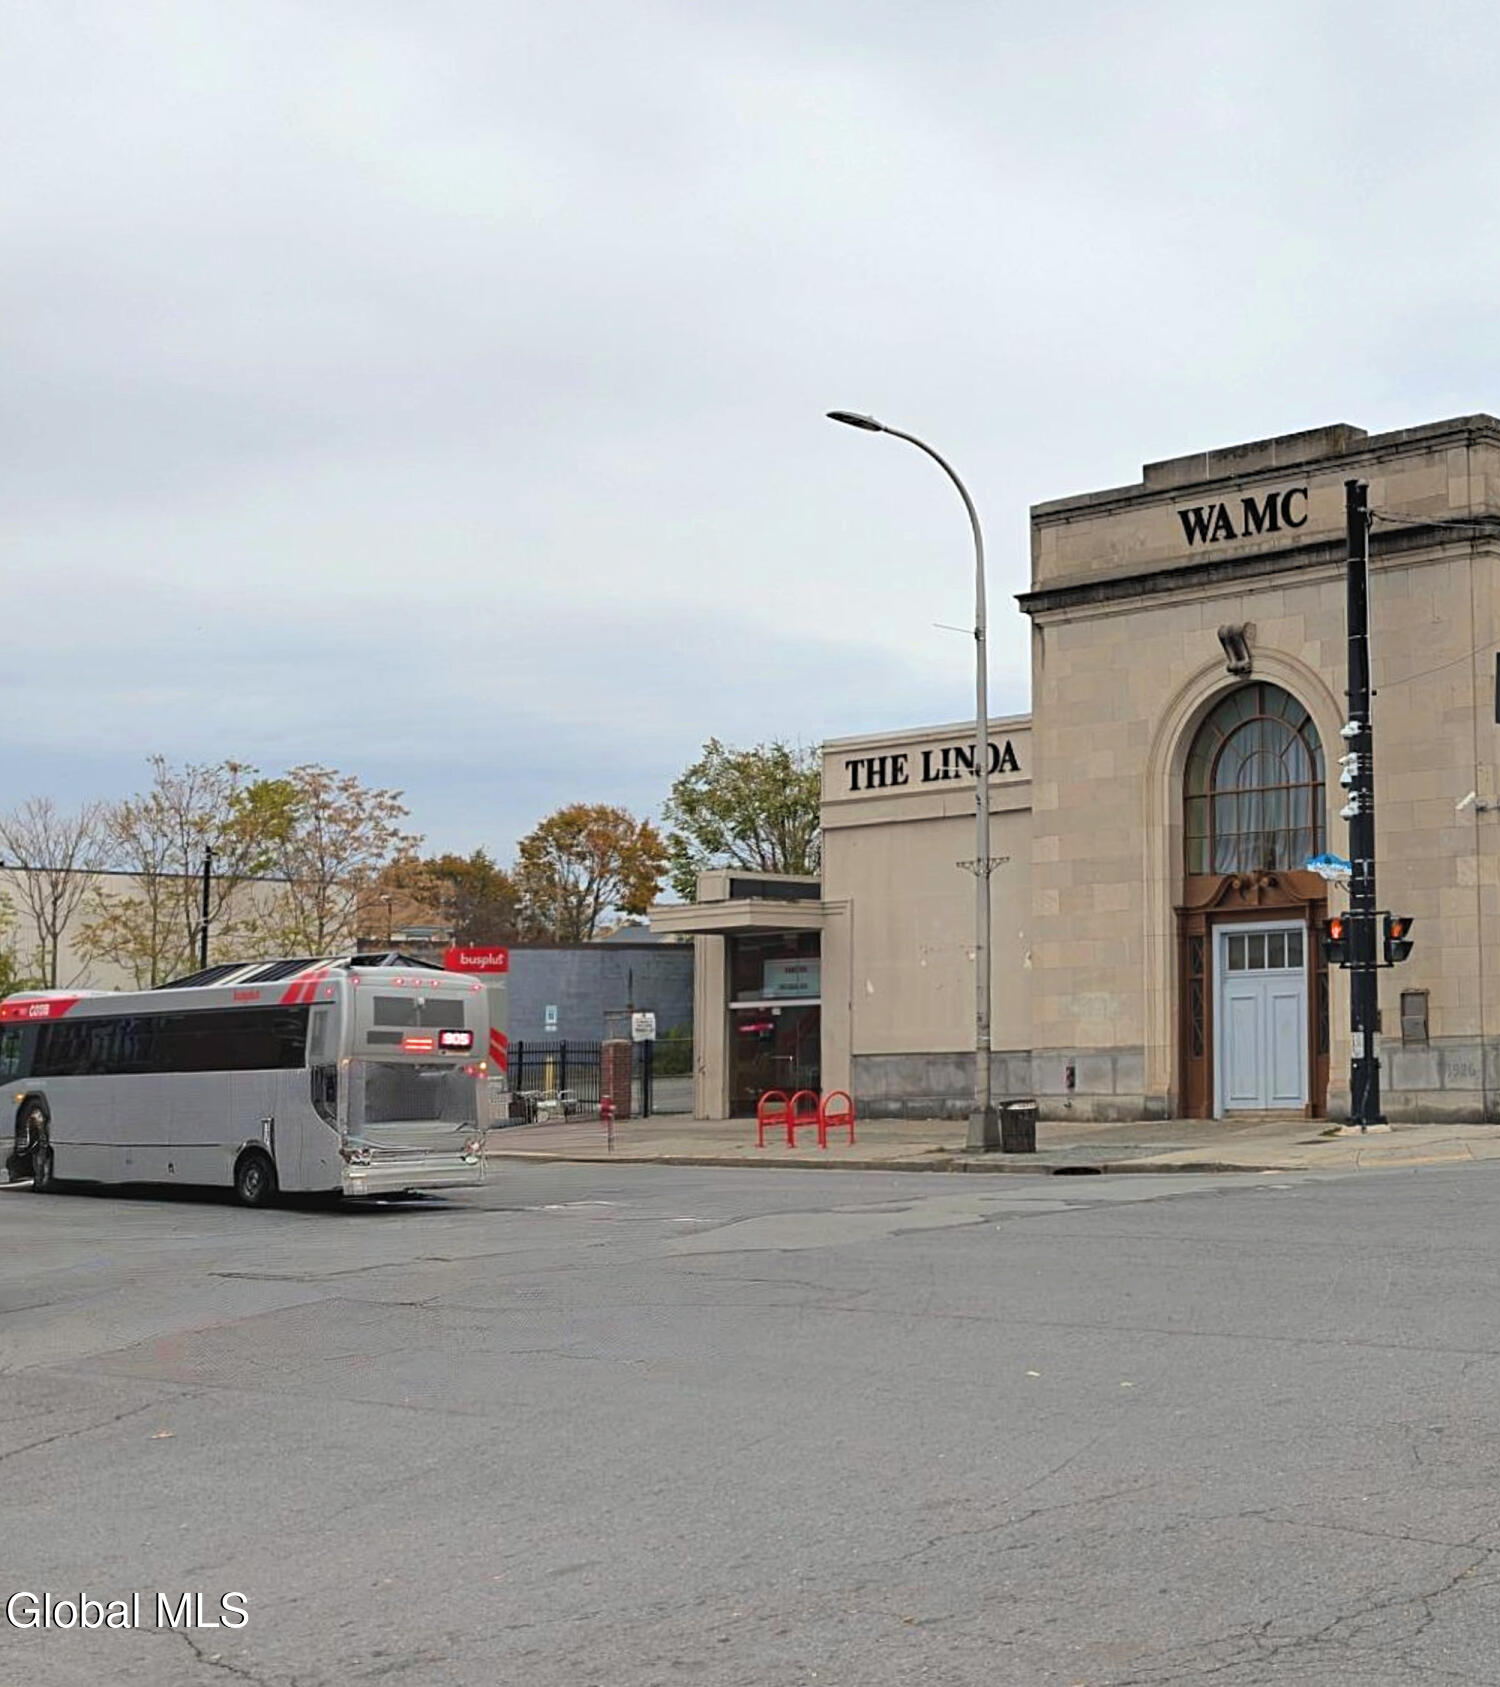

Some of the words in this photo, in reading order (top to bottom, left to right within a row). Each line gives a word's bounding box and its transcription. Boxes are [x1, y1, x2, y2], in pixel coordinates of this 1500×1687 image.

[1177, 487, 1308, 546] WAMC
[845, 753, 909, 791] THE
[441, 1032, 471, 1045] 905
